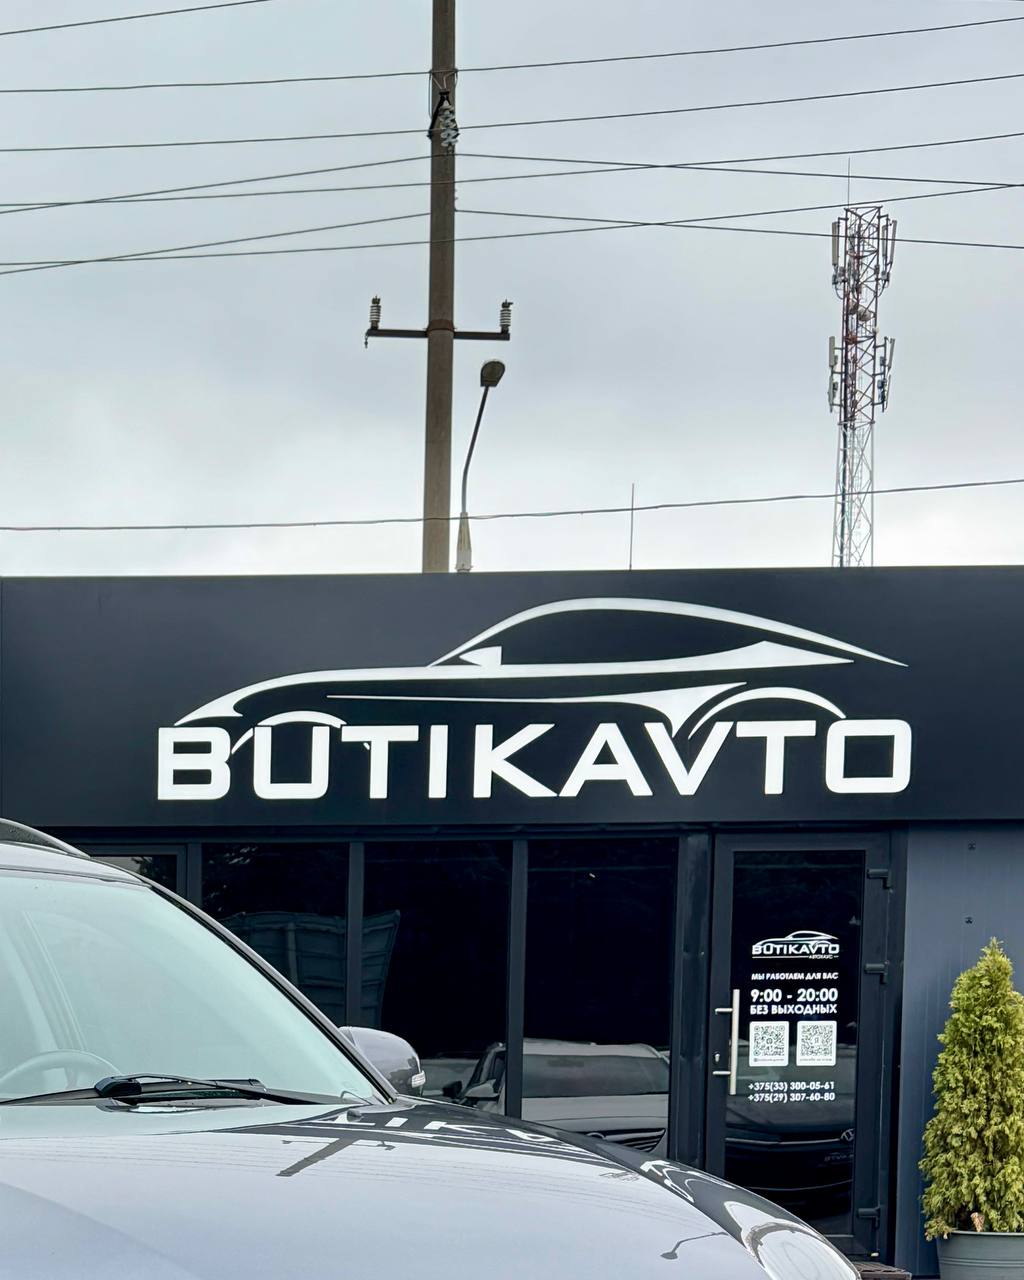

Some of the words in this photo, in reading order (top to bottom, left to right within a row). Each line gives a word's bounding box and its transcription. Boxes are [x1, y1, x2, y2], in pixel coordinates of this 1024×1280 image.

[157, 718, 912, 801] BUTIKAVTO
[751, 943, 840, 955] BUTIKAVTO
[751, 973, 765, 981] МЫ
[805, 972, 822, 980] ДЛЯ
[822, 972, 839, 980] ВАС
[750, 988, 783, 1003] 9:00
[797, 988, 839, 1002] 20:00
[750, 1004, 769, 1015] БЕЗ
[771, 1004, 838, 1016] ВЫХОДНЫХ
[748, 1081, 788, 1092] +375(33)
[789, 1081, 835, 1091] 300-05-61
[747, 1092, 788, 1103] +375(29)
[789, 1092, 836, 1102] 307-60-80
